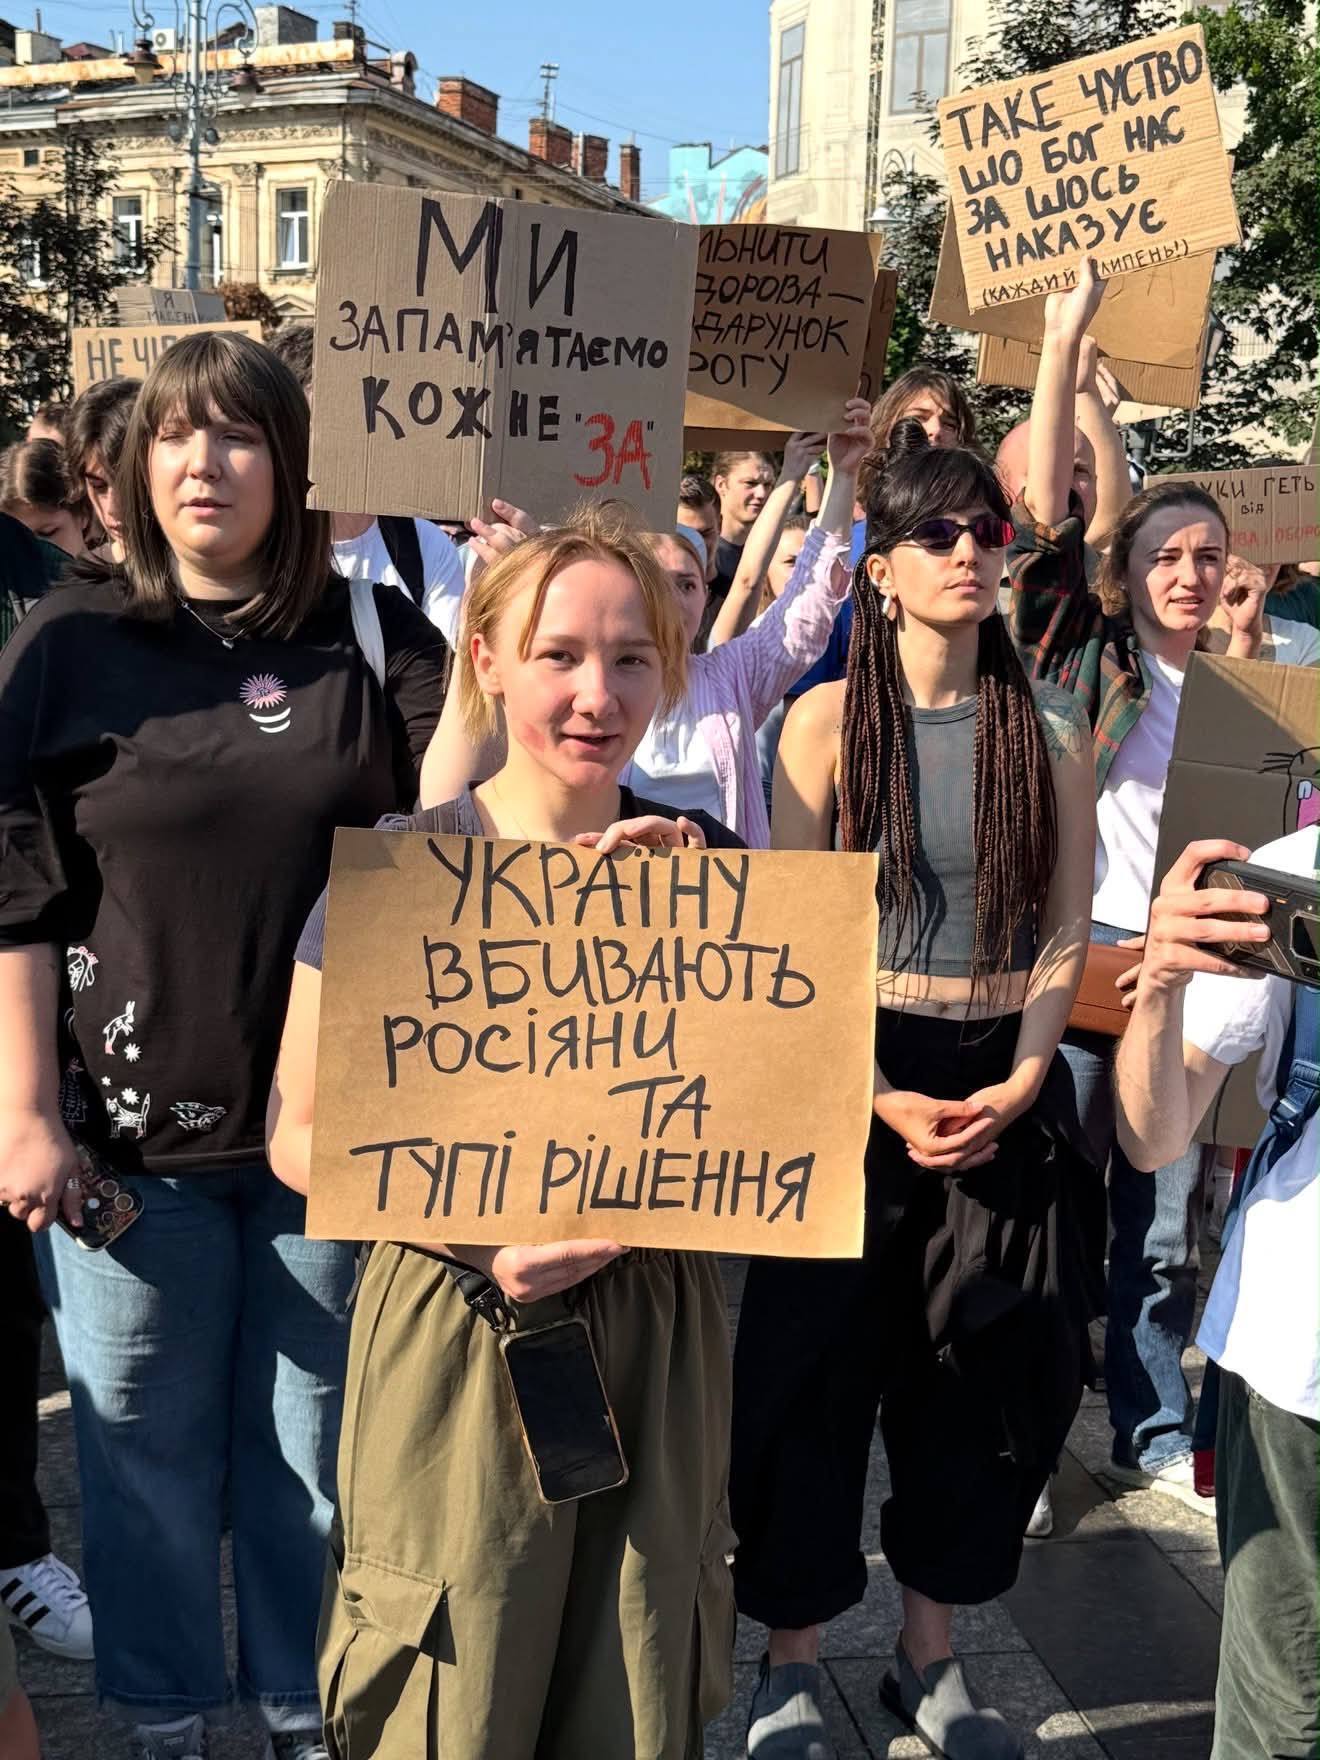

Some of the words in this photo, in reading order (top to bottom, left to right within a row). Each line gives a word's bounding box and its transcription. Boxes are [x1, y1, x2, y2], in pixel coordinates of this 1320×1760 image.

[946, 81, 1062, 151] ТАКЕ
[1078, 40, 1202, 115] ЧУСТВО
[959, 150, 1023, 195] ШО
[1041, 122, 1104, 174] БОГ
[1124, 105, 1185, 152] НАС
[965, 195, 1010, 235] ЗА
[1025, 164, 1140, 220] ШОСЬ
[985, 198, 1167, 272] НАКАЗУЄ
[416, 197, 578, 316] МИ
[87, 337, 124, 381] НЕ
[692, 312, 850, 356] ДАРУНОК
[362, 376, 560, 442] КОЖНЕ
[1264, 475, 1315, 497] ГЕТЬ
[428, 837, 749, 940] УКРАЇНУ
[422, 935, 816, 1010] ВБИВАЮТЬ
[383, 1008, 677, 1088] РОСІЯНИ
[608, 1074, 711, 1139] ТА
[349, 1130, 517, 1219] ТУПІ
[539, 1133, 816, 1224] РІШЕННЯ
